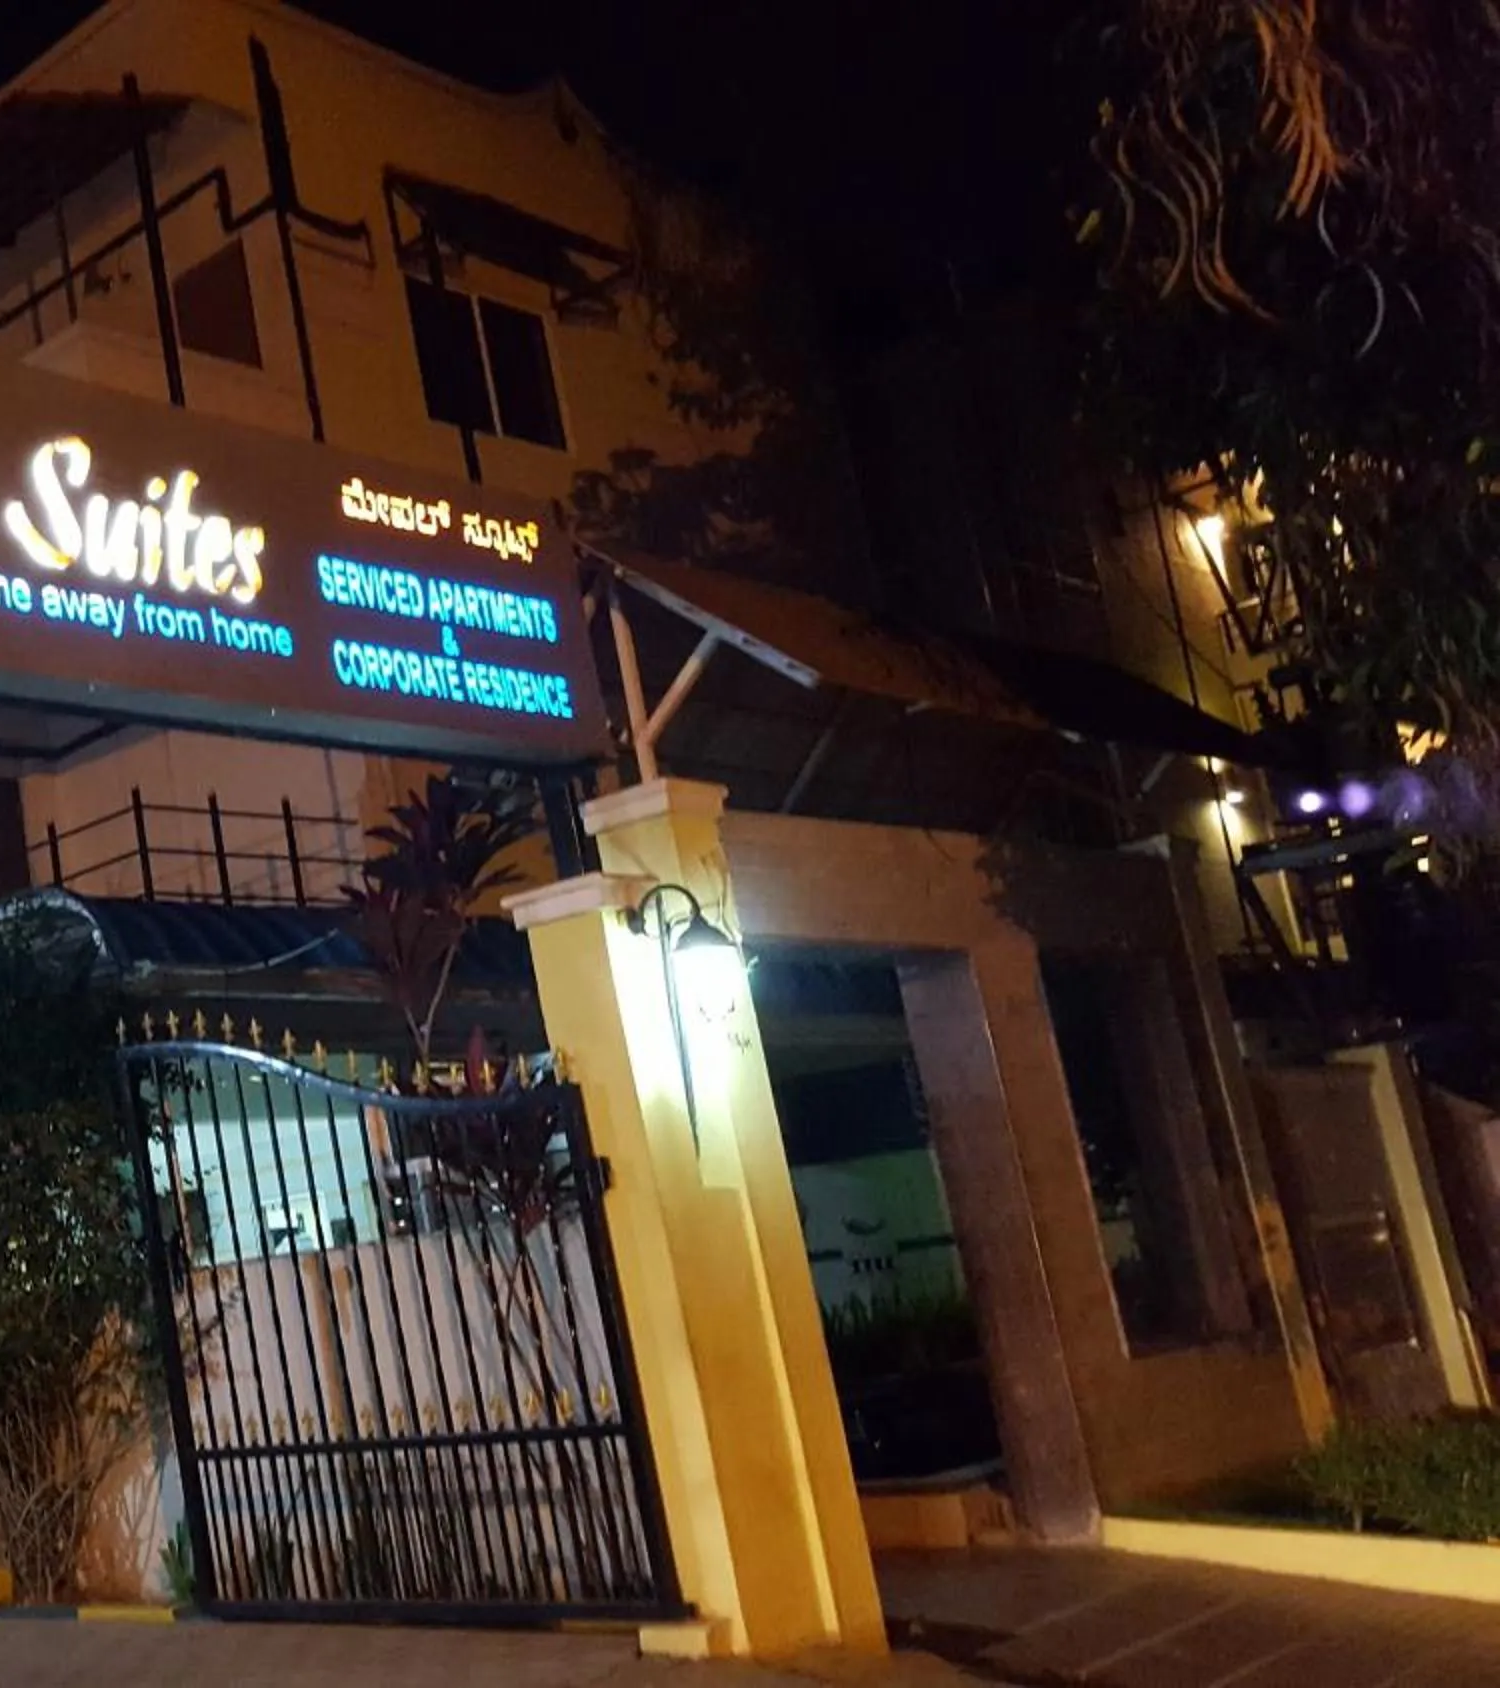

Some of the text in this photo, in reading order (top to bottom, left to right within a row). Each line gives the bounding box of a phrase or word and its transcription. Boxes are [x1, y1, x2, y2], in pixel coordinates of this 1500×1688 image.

[6, 435, 265, 602] Suites
[41, 584, 125, 638] away
[134, 592, 206, 643] from
[211, 607, 294, 657] home
[317, 555, 558, 643] SERVICED APARTMENTS
[332, 639, 574, 719] CORPORATE RESIDENCE
[441, 625, 461, 657] &
